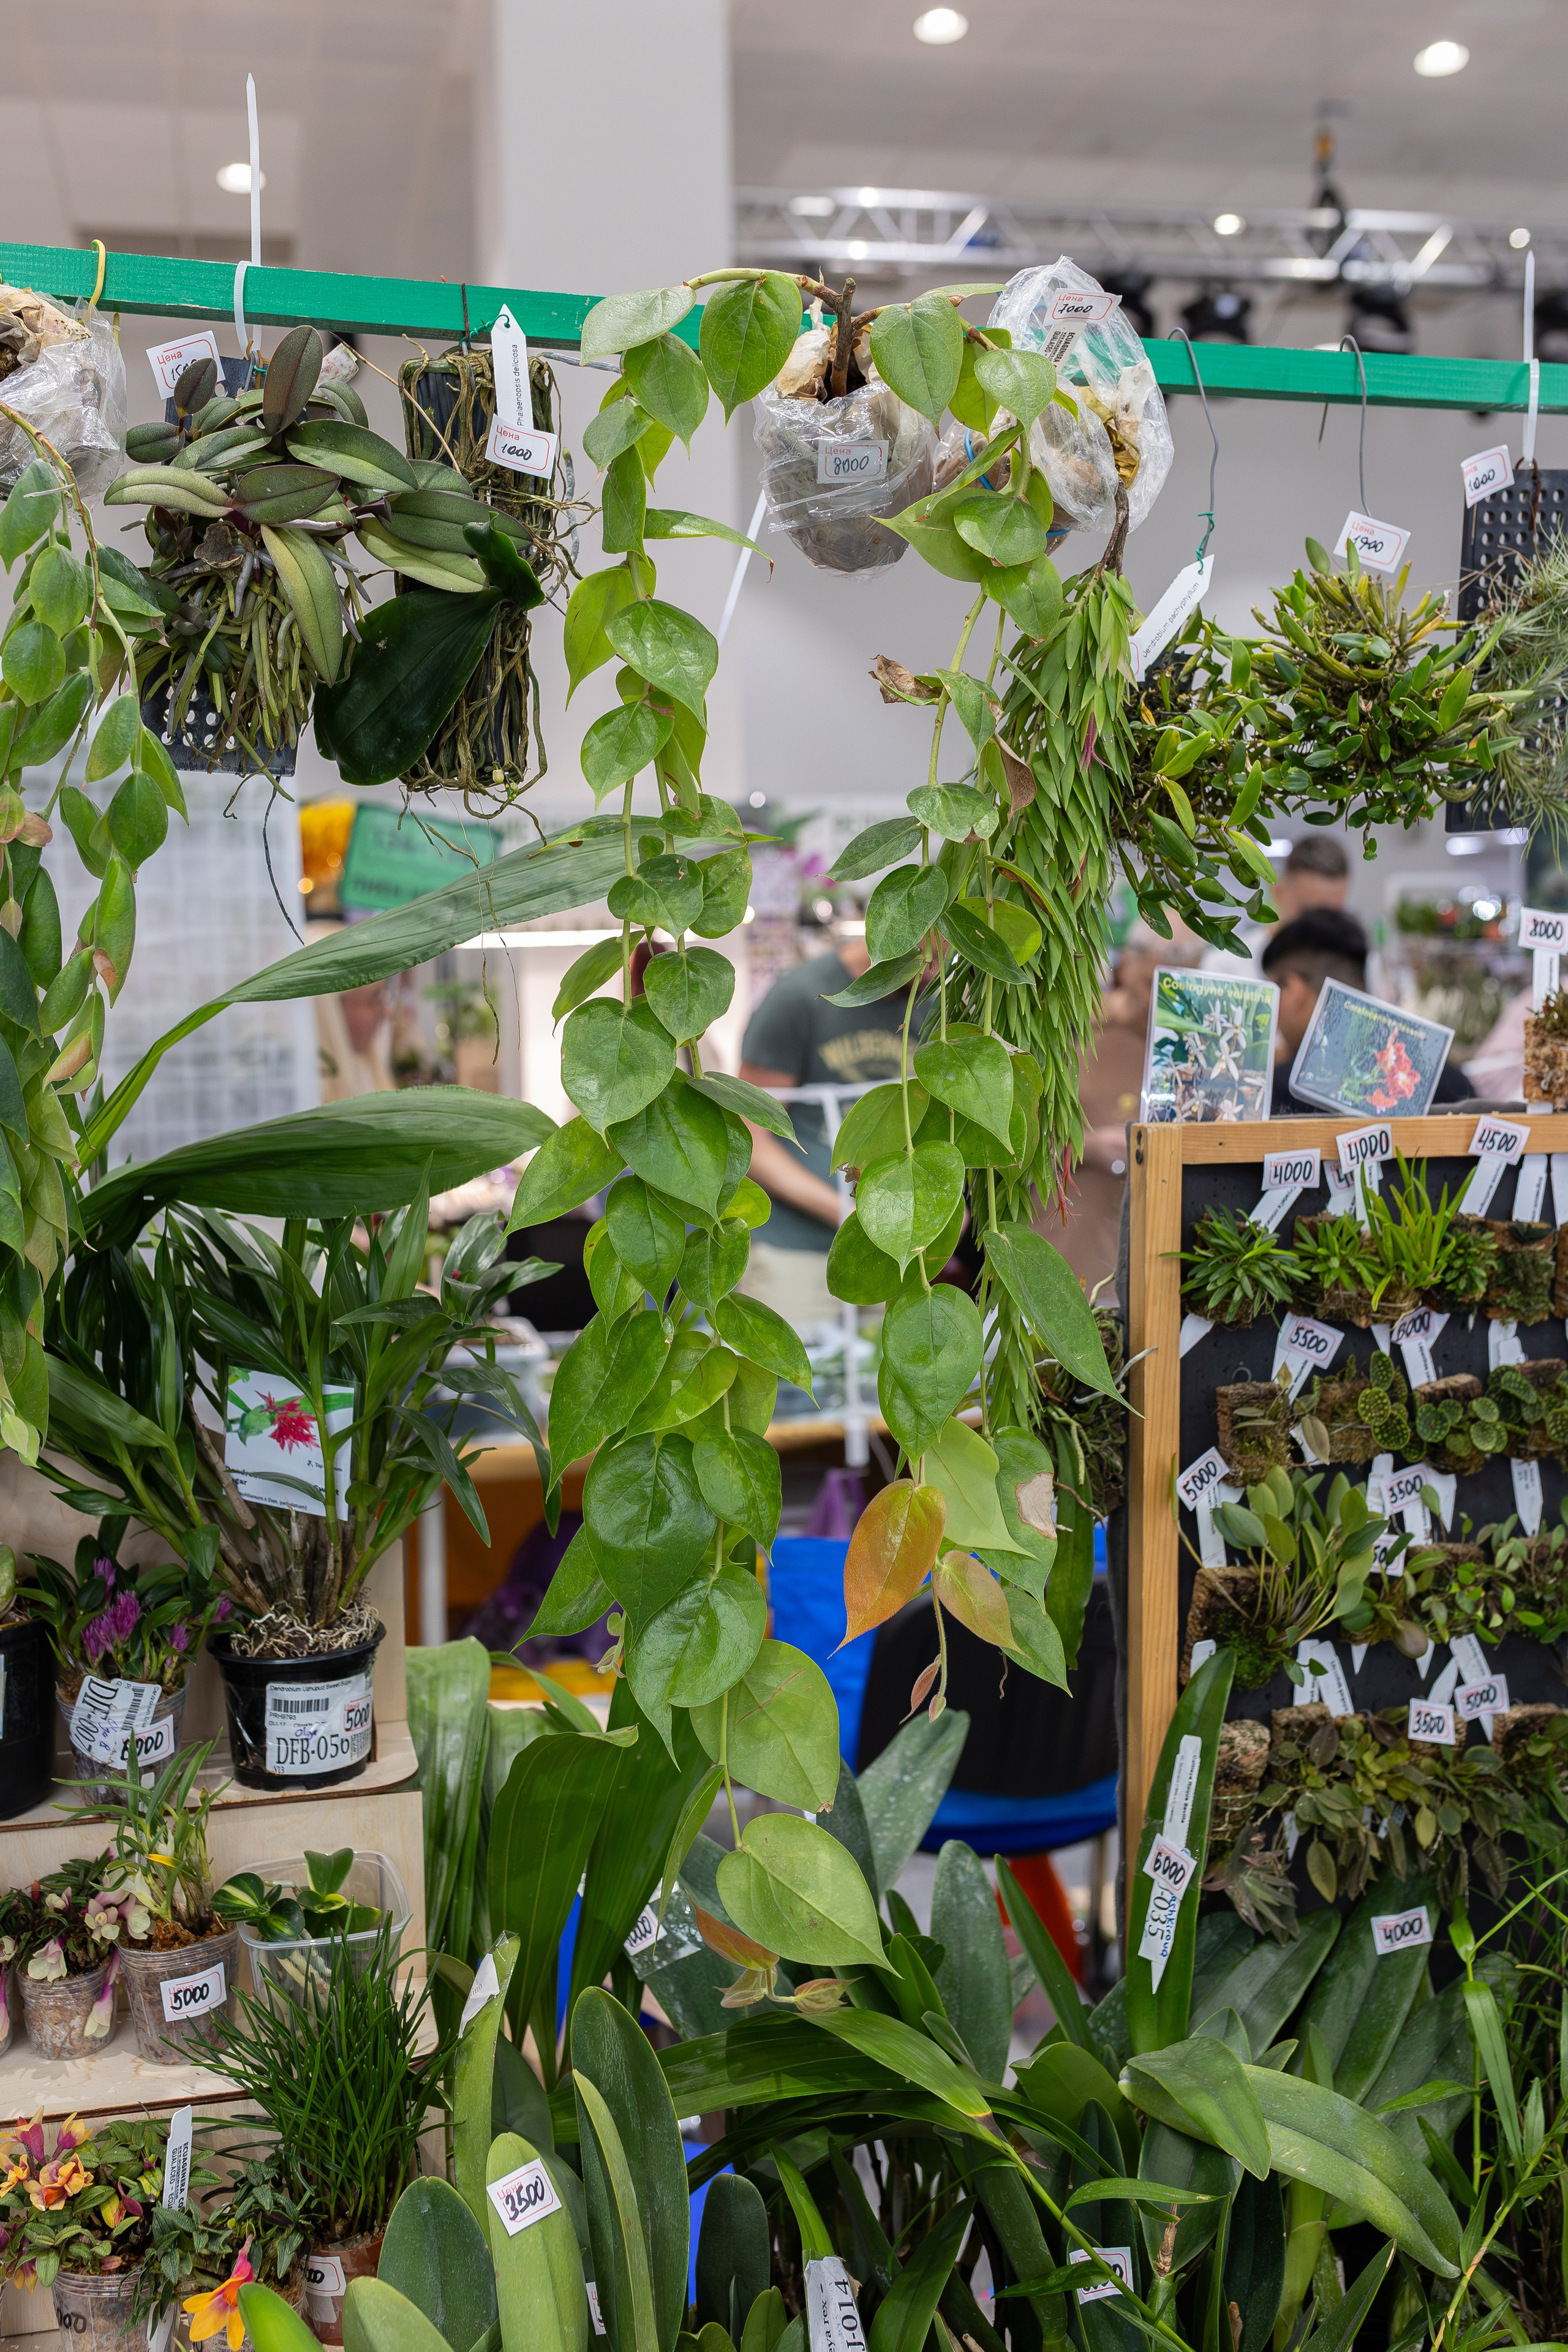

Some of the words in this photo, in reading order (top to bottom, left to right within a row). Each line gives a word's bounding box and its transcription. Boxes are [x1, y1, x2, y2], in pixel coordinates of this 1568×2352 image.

[1044, 331, 1061, 353] GUALACEO
[1053, 332, 1076, 363] ECUAGENERA
[157, 351, 183, 365] Цена
[170, 359, 197, 381] 15
[512, 344, 521, 376] deliciosa
[513, 377, 524, 426] Phalaenopsis
[496, 424, 520, 440] Цена
[501, 443, 532, 461] 1000
[825, 447, 851, 456] Цена
[833, 456, 869, 475] 8000
[1469, 469, 1495, 491] 1000
[1351, 521, 1375, 536] Цена
[1169, 582, 1199, 624] pachyphyllum
[1349, 1130, 1389, 1164] 4000
[1479, 1129, 1517, 1152] 4500
[1273, 1161, 1313, 1184] 4000
[1290, 1326, 1328, 1353] 5500
[1183, 1461, 1218, 1502] 5000
[1389, 1474, 1423, 1504] 3500
[1466, 1684, 1497, 1712] 5000
[1412, 1710, 1445, 1733] 3500
[1383, 1918, 1422, 1943] 4000
[170, 1983, 209, 2010] 5000
[169, 2148, 178, 2185] GUALACEO
[179, 2141, 189, 2195] ECUAGENERA
[497, 2181, 523, 2200] Цена
[505, 2175, 545, 2221] 3500
[834, 2278, 866, 2351] J-014
